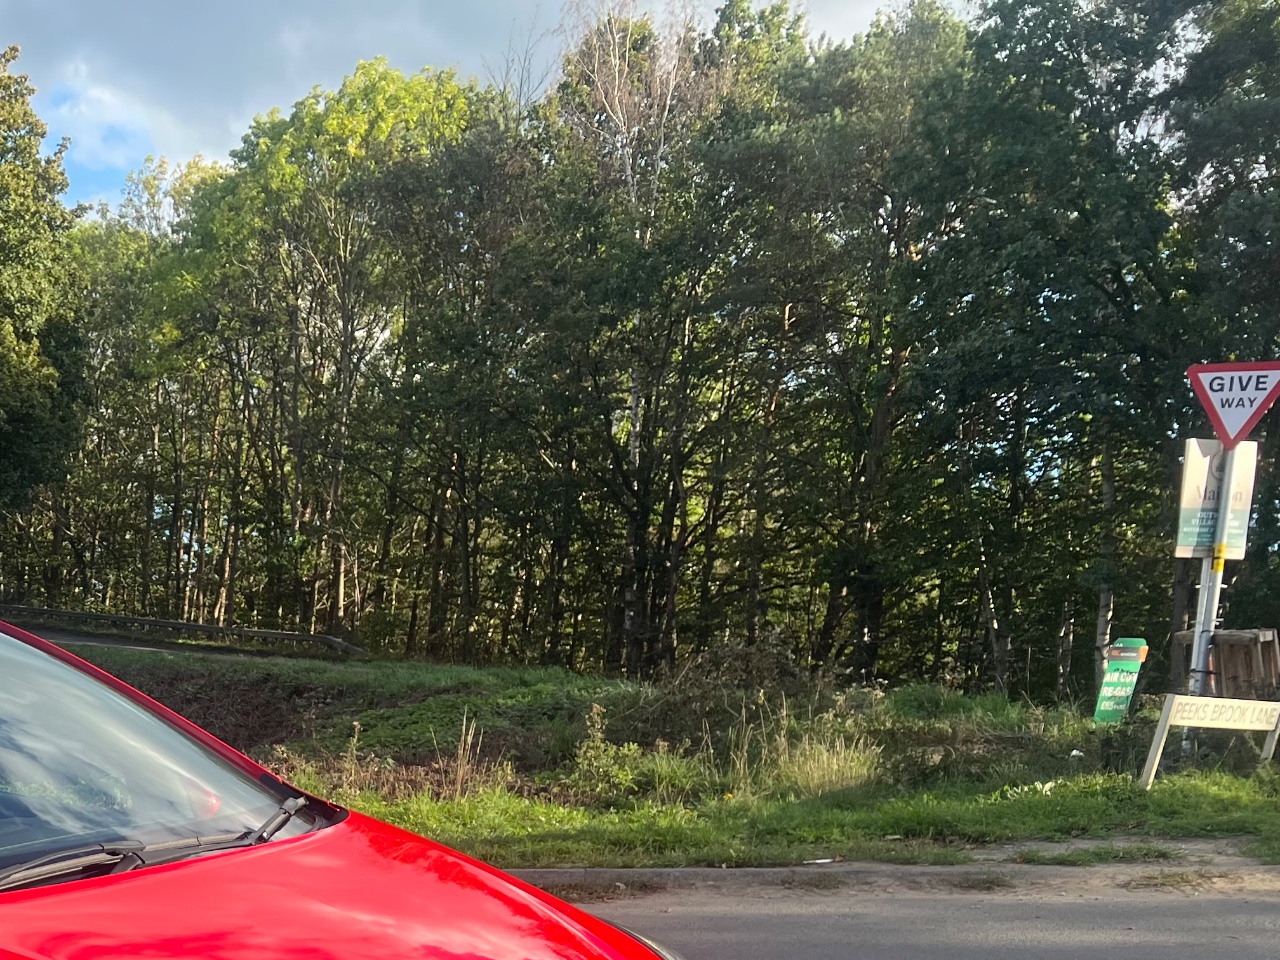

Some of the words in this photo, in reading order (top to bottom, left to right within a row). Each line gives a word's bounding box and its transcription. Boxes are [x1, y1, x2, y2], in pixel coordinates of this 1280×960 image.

[1209, 375, 1269, 392] GIVE
[1220, 397, 1258, 409] WAY
[1104, 672, 1120, 683] AIR
[1102, 686, 1131, 697] RE-GAS
[1175, 702, 1210, 721] PEEKS
[1210, 704, 1249, 723] BROOK
[1249, 706, 1277, 725] LANE
